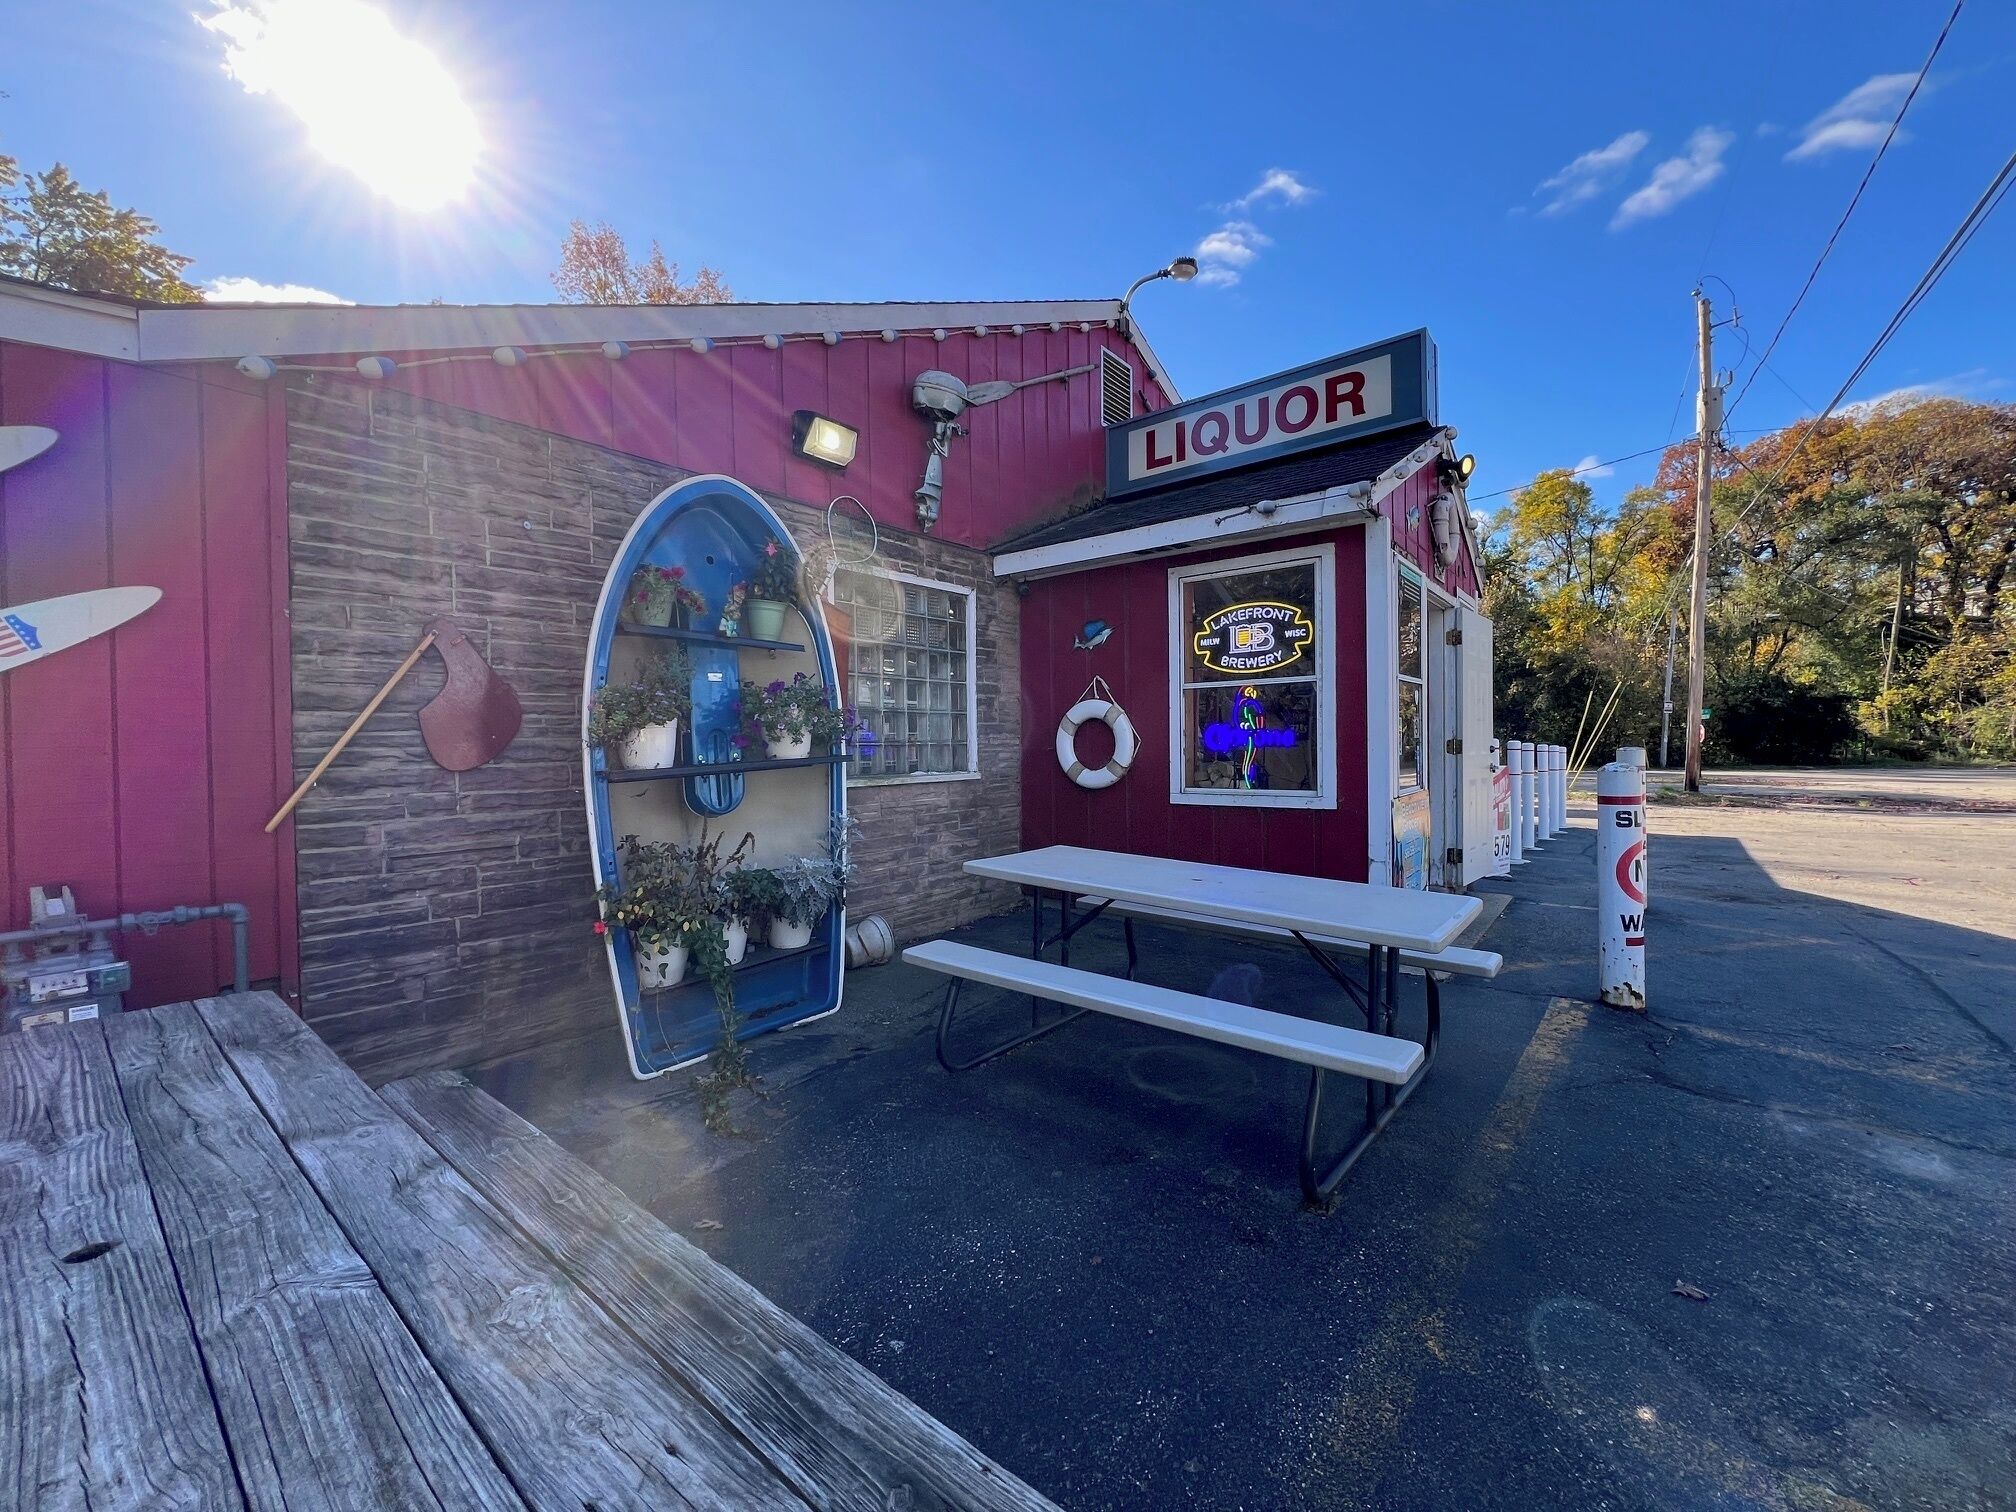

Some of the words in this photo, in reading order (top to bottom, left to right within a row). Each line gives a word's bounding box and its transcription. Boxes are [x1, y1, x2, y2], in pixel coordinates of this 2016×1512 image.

[1146, 371, 1366, 470] LIQUOR
[1210, 607, 1294, 631] LAKEFRONT
[1200, 637, 1220, 647] MILW
[1284, 628, 1307, 638] WISC
[1220, 650, 1283, 669] BREWERY
